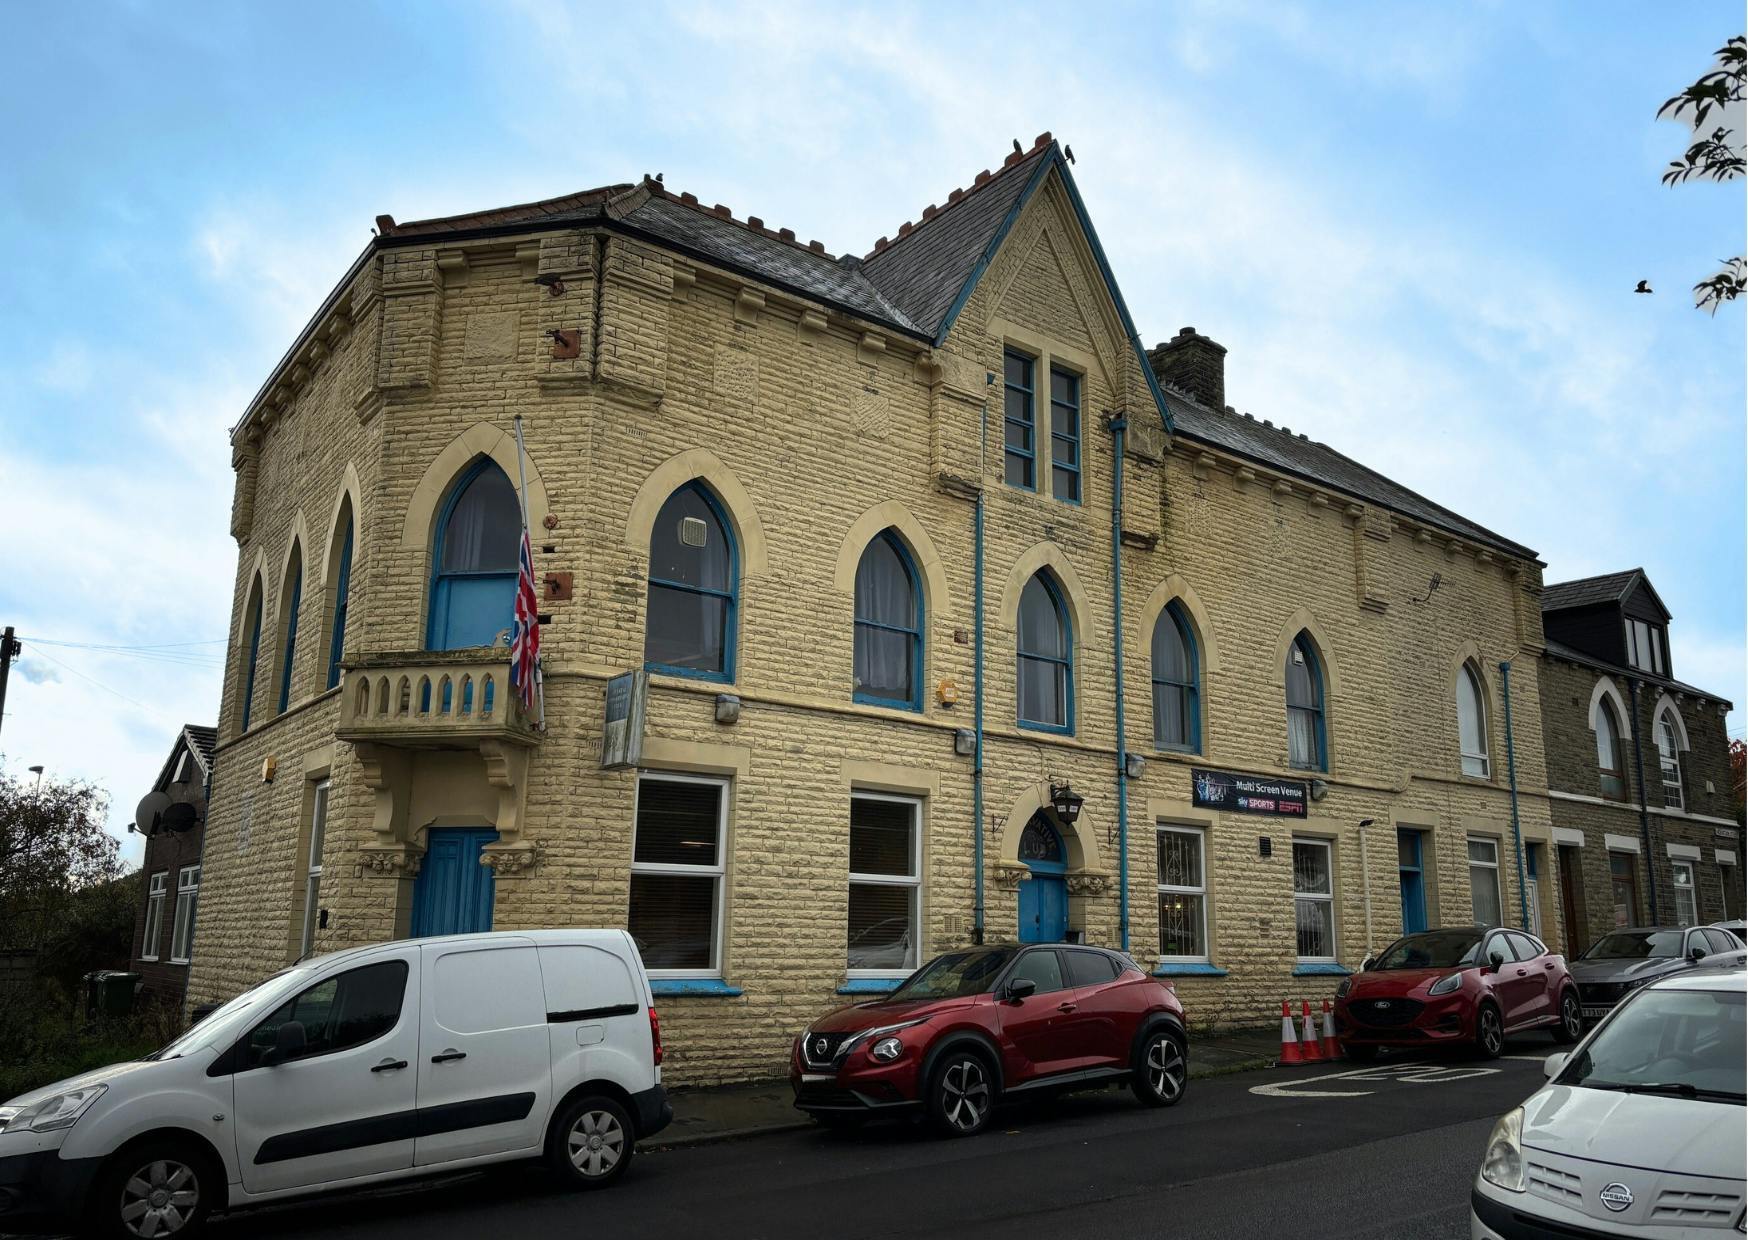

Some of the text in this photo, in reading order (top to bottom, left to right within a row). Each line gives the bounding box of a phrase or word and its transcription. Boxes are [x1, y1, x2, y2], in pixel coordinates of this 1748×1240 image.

[1236, 780, 1303, 797] Multi Screen Venue
[1238, 796, 1303, 813] sky SPORTS ESPN
[1602, 1192, 1630, 1202] NISSAN
